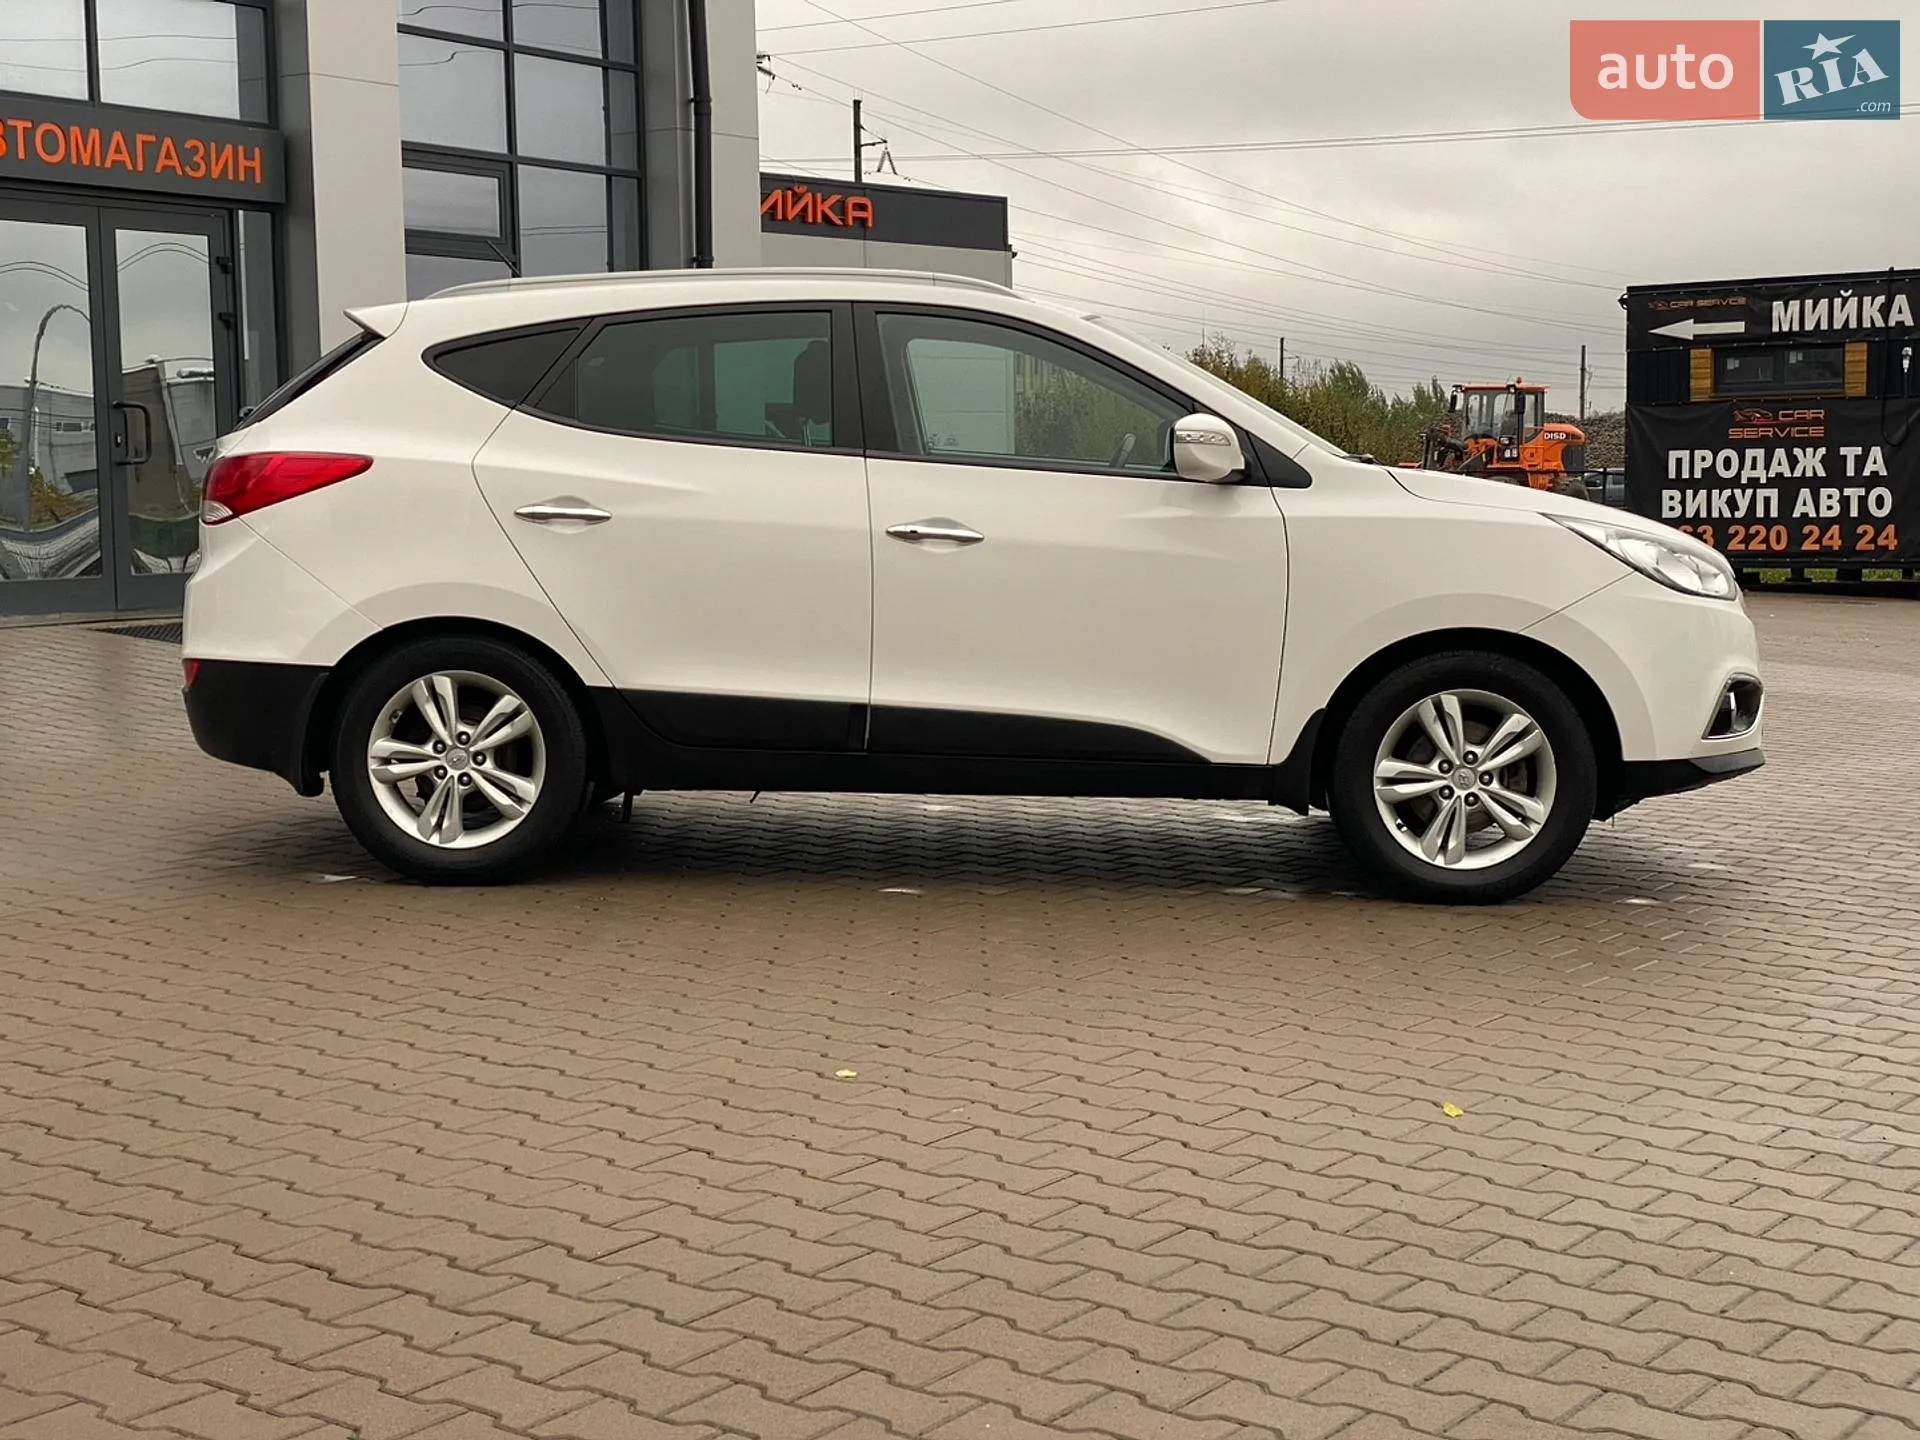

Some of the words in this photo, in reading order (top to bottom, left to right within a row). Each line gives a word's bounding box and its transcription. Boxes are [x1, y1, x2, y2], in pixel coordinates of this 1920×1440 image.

[1771, 289, 1915, 333] МИЙКА
[1778, 409, 1825, 421] CAR
[1728, 426, 1825, 439] SERVICE
[1667, 446, 1827, 484] ПРОДАЖ
[1839, 446, 1888, 477] ТА
[1661, 488, 1779, 519] ВИКУП
[1792, 486, 1893, 518] АВТО
[1727, 524, 1789, 551] 220
[1801, 524, 1843, 551] 24
[1855, 523, 1899, 551] 24
